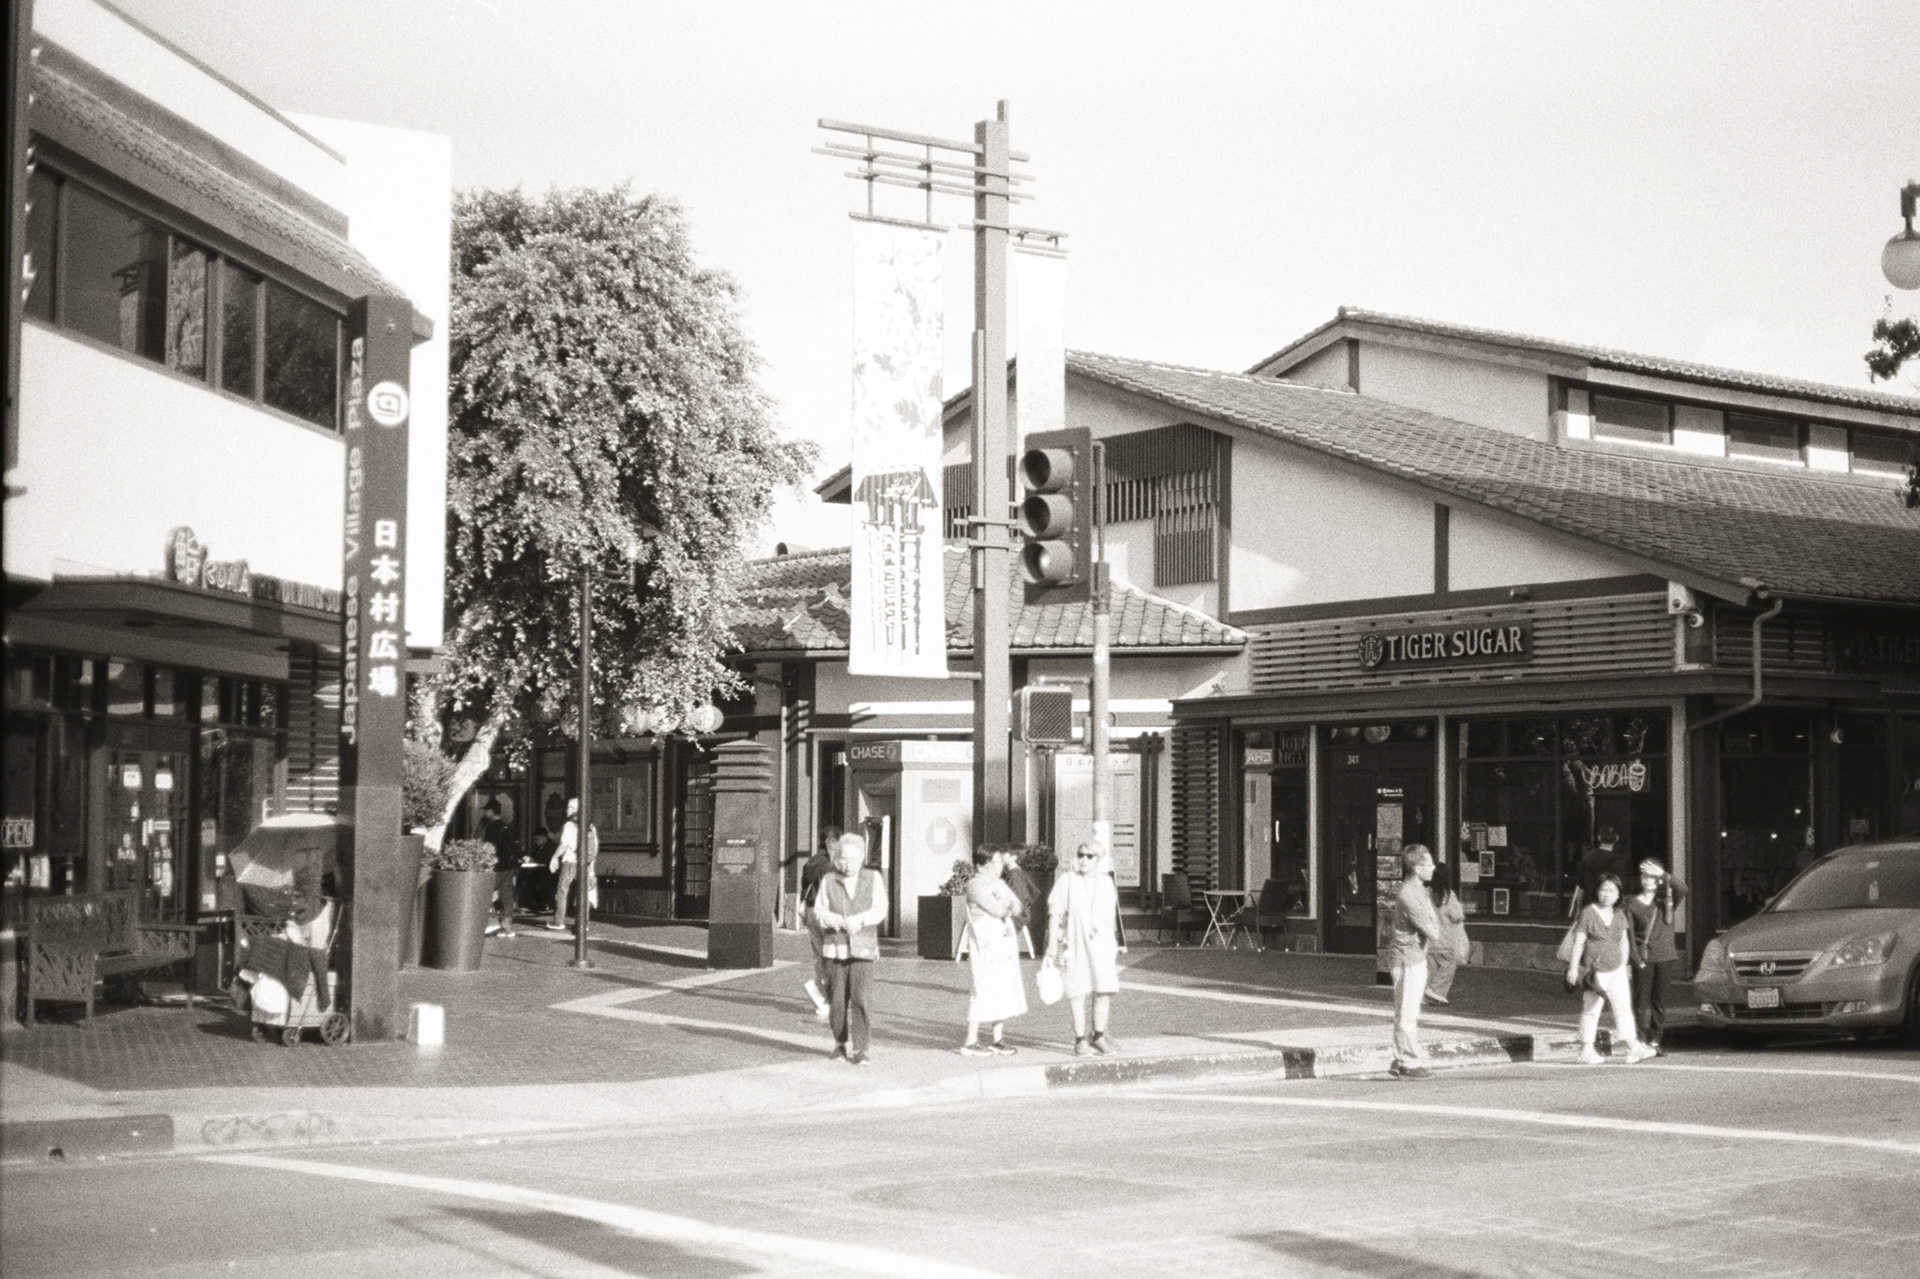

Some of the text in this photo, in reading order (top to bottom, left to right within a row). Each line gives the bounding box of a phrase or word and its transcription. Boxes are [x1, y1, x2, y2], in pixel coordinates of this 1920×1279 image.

[341, 337, 365, 745] Japanese Village Plaza
[368, 520, 400, 698] 日本村広場
[1385, 626, 1523, 661] TIGER SUGAR
[850, 746, 886, 760] CHASE
[1347, 754, 1359, 765] 341
[1589, 763, 1629, 789] BOBA
